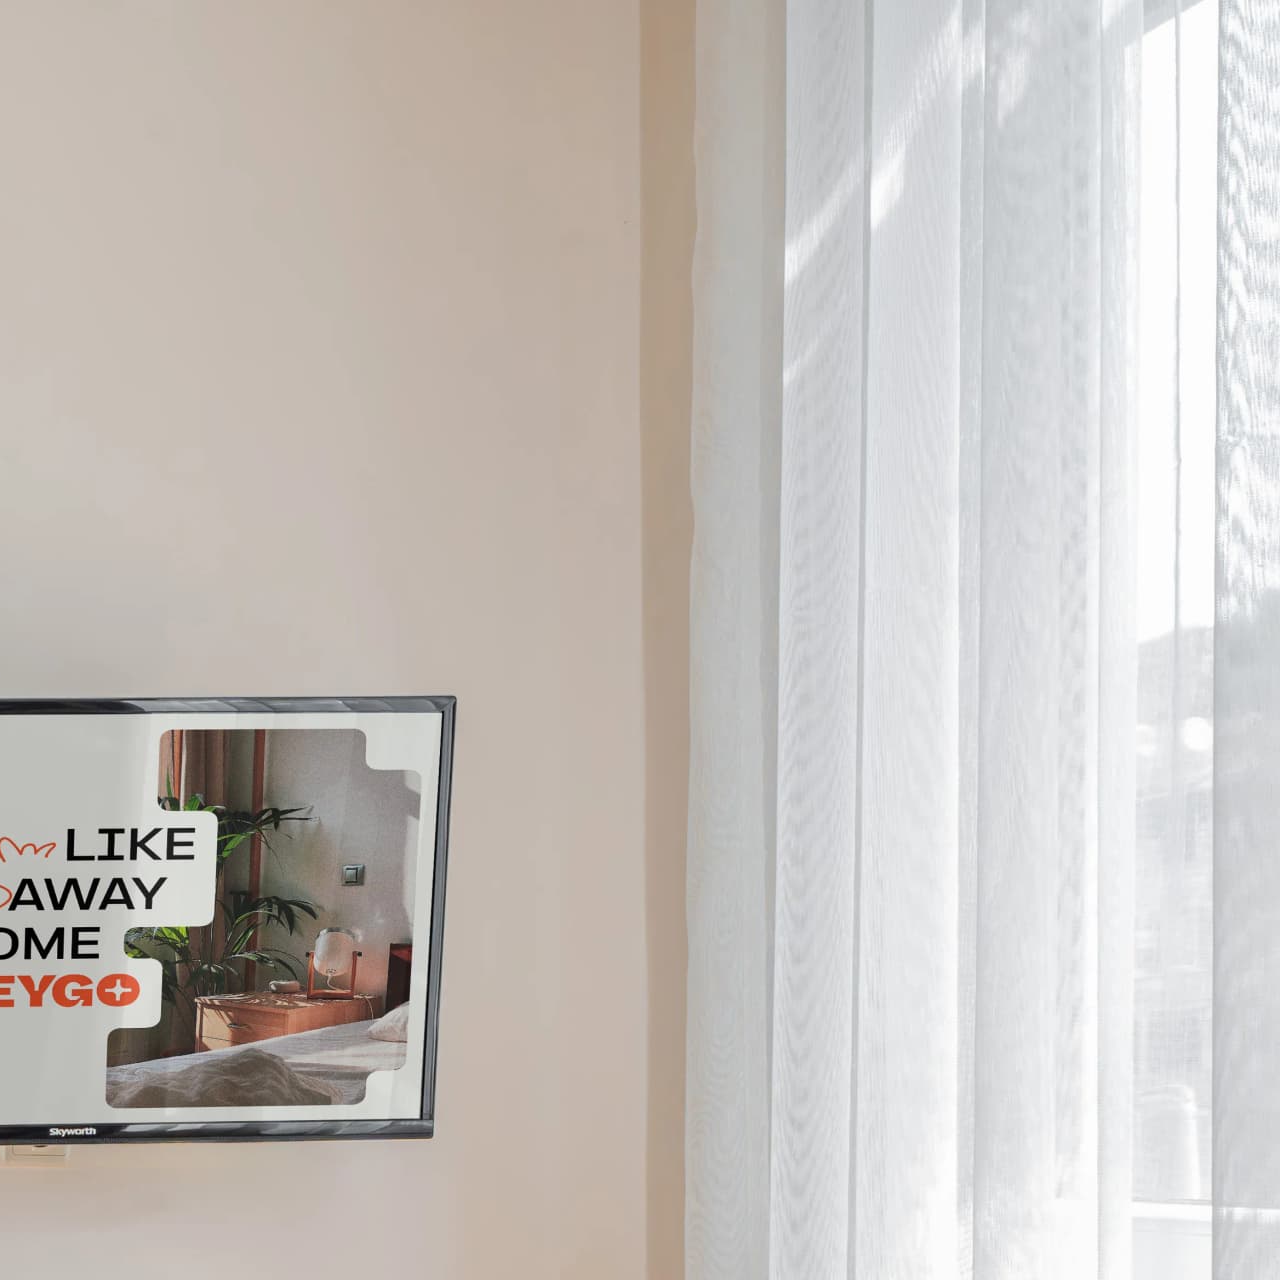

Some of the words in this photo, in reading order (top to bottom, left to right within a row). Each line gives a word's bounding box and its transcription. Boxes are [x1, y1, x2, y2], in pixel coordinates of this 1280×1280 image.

[66, 827, 196, 861] LIKE
[7, 876, 168, 912] AWAY
[48, 1127, 97, 1137] Skyworth
